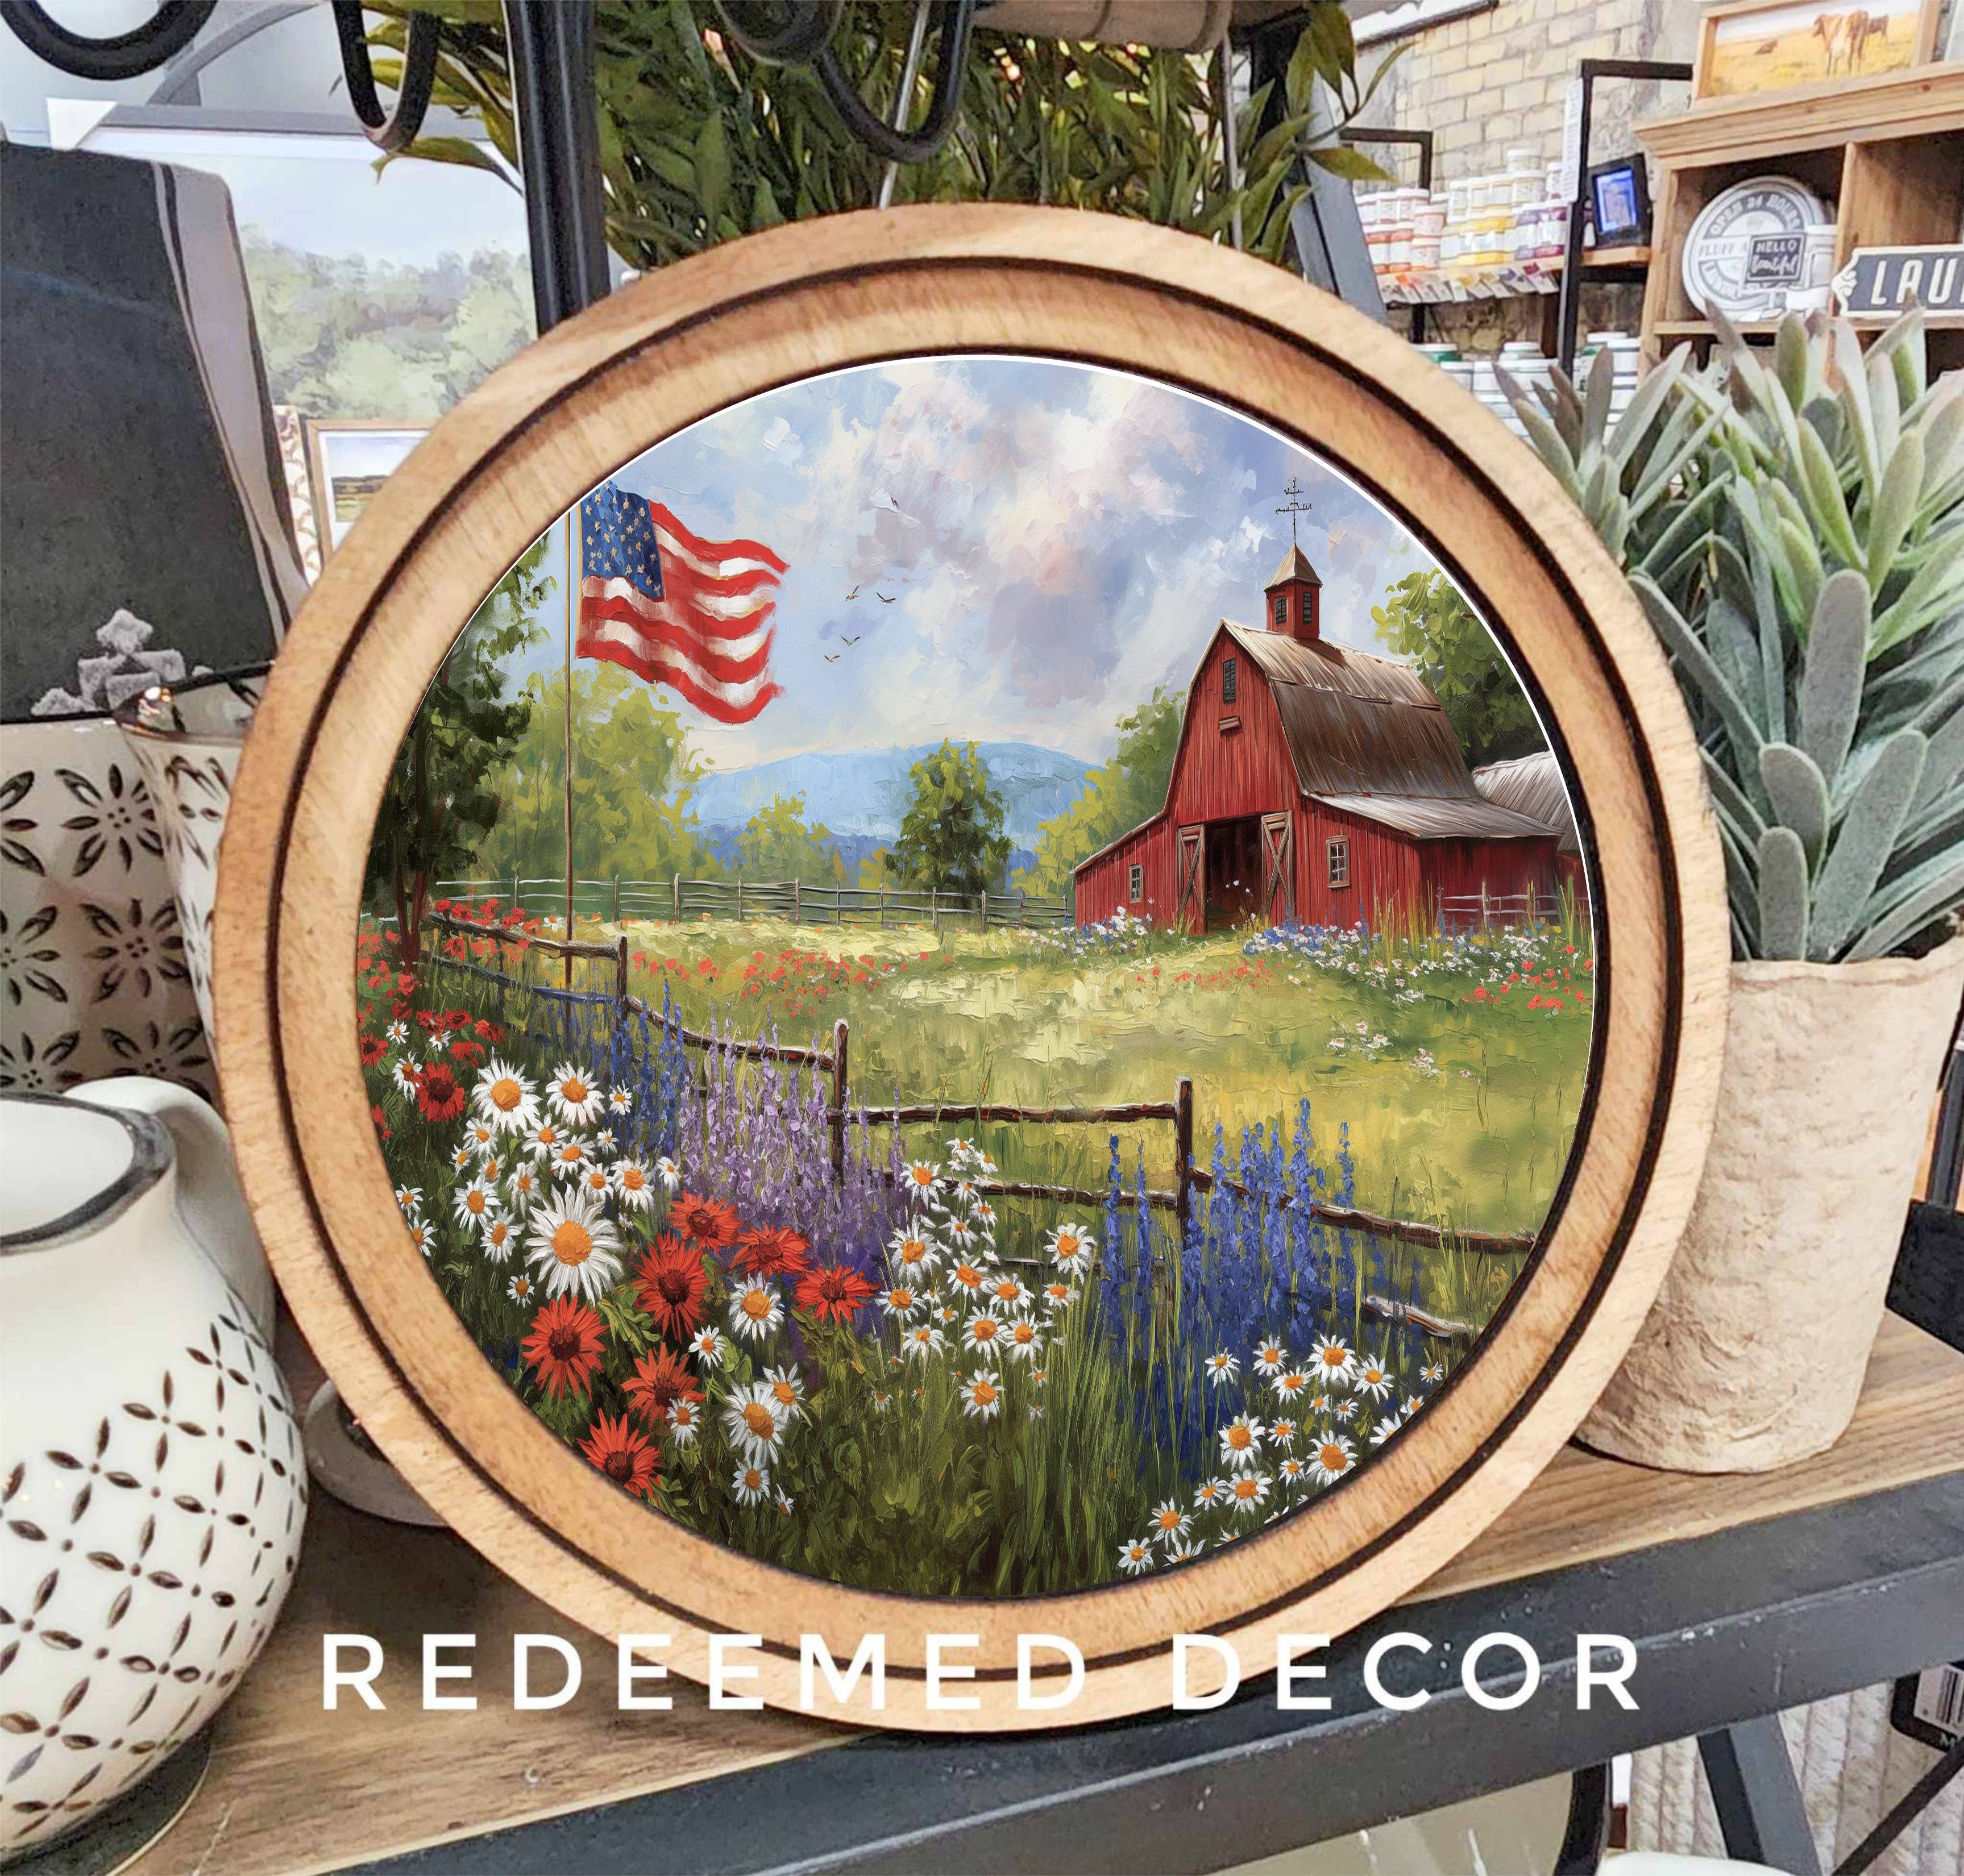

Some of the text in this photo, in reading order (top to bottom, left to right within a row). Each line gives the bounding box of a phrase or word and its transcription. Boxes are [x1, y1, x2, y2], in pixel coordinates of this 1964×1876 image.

[1710, 200, 1743, 235] OPEN
[1766, 193, 1801, 230] HOURS
[1755, 239, 1797, 253] HELLO
[1870, 257, 1964, 305] LAU
